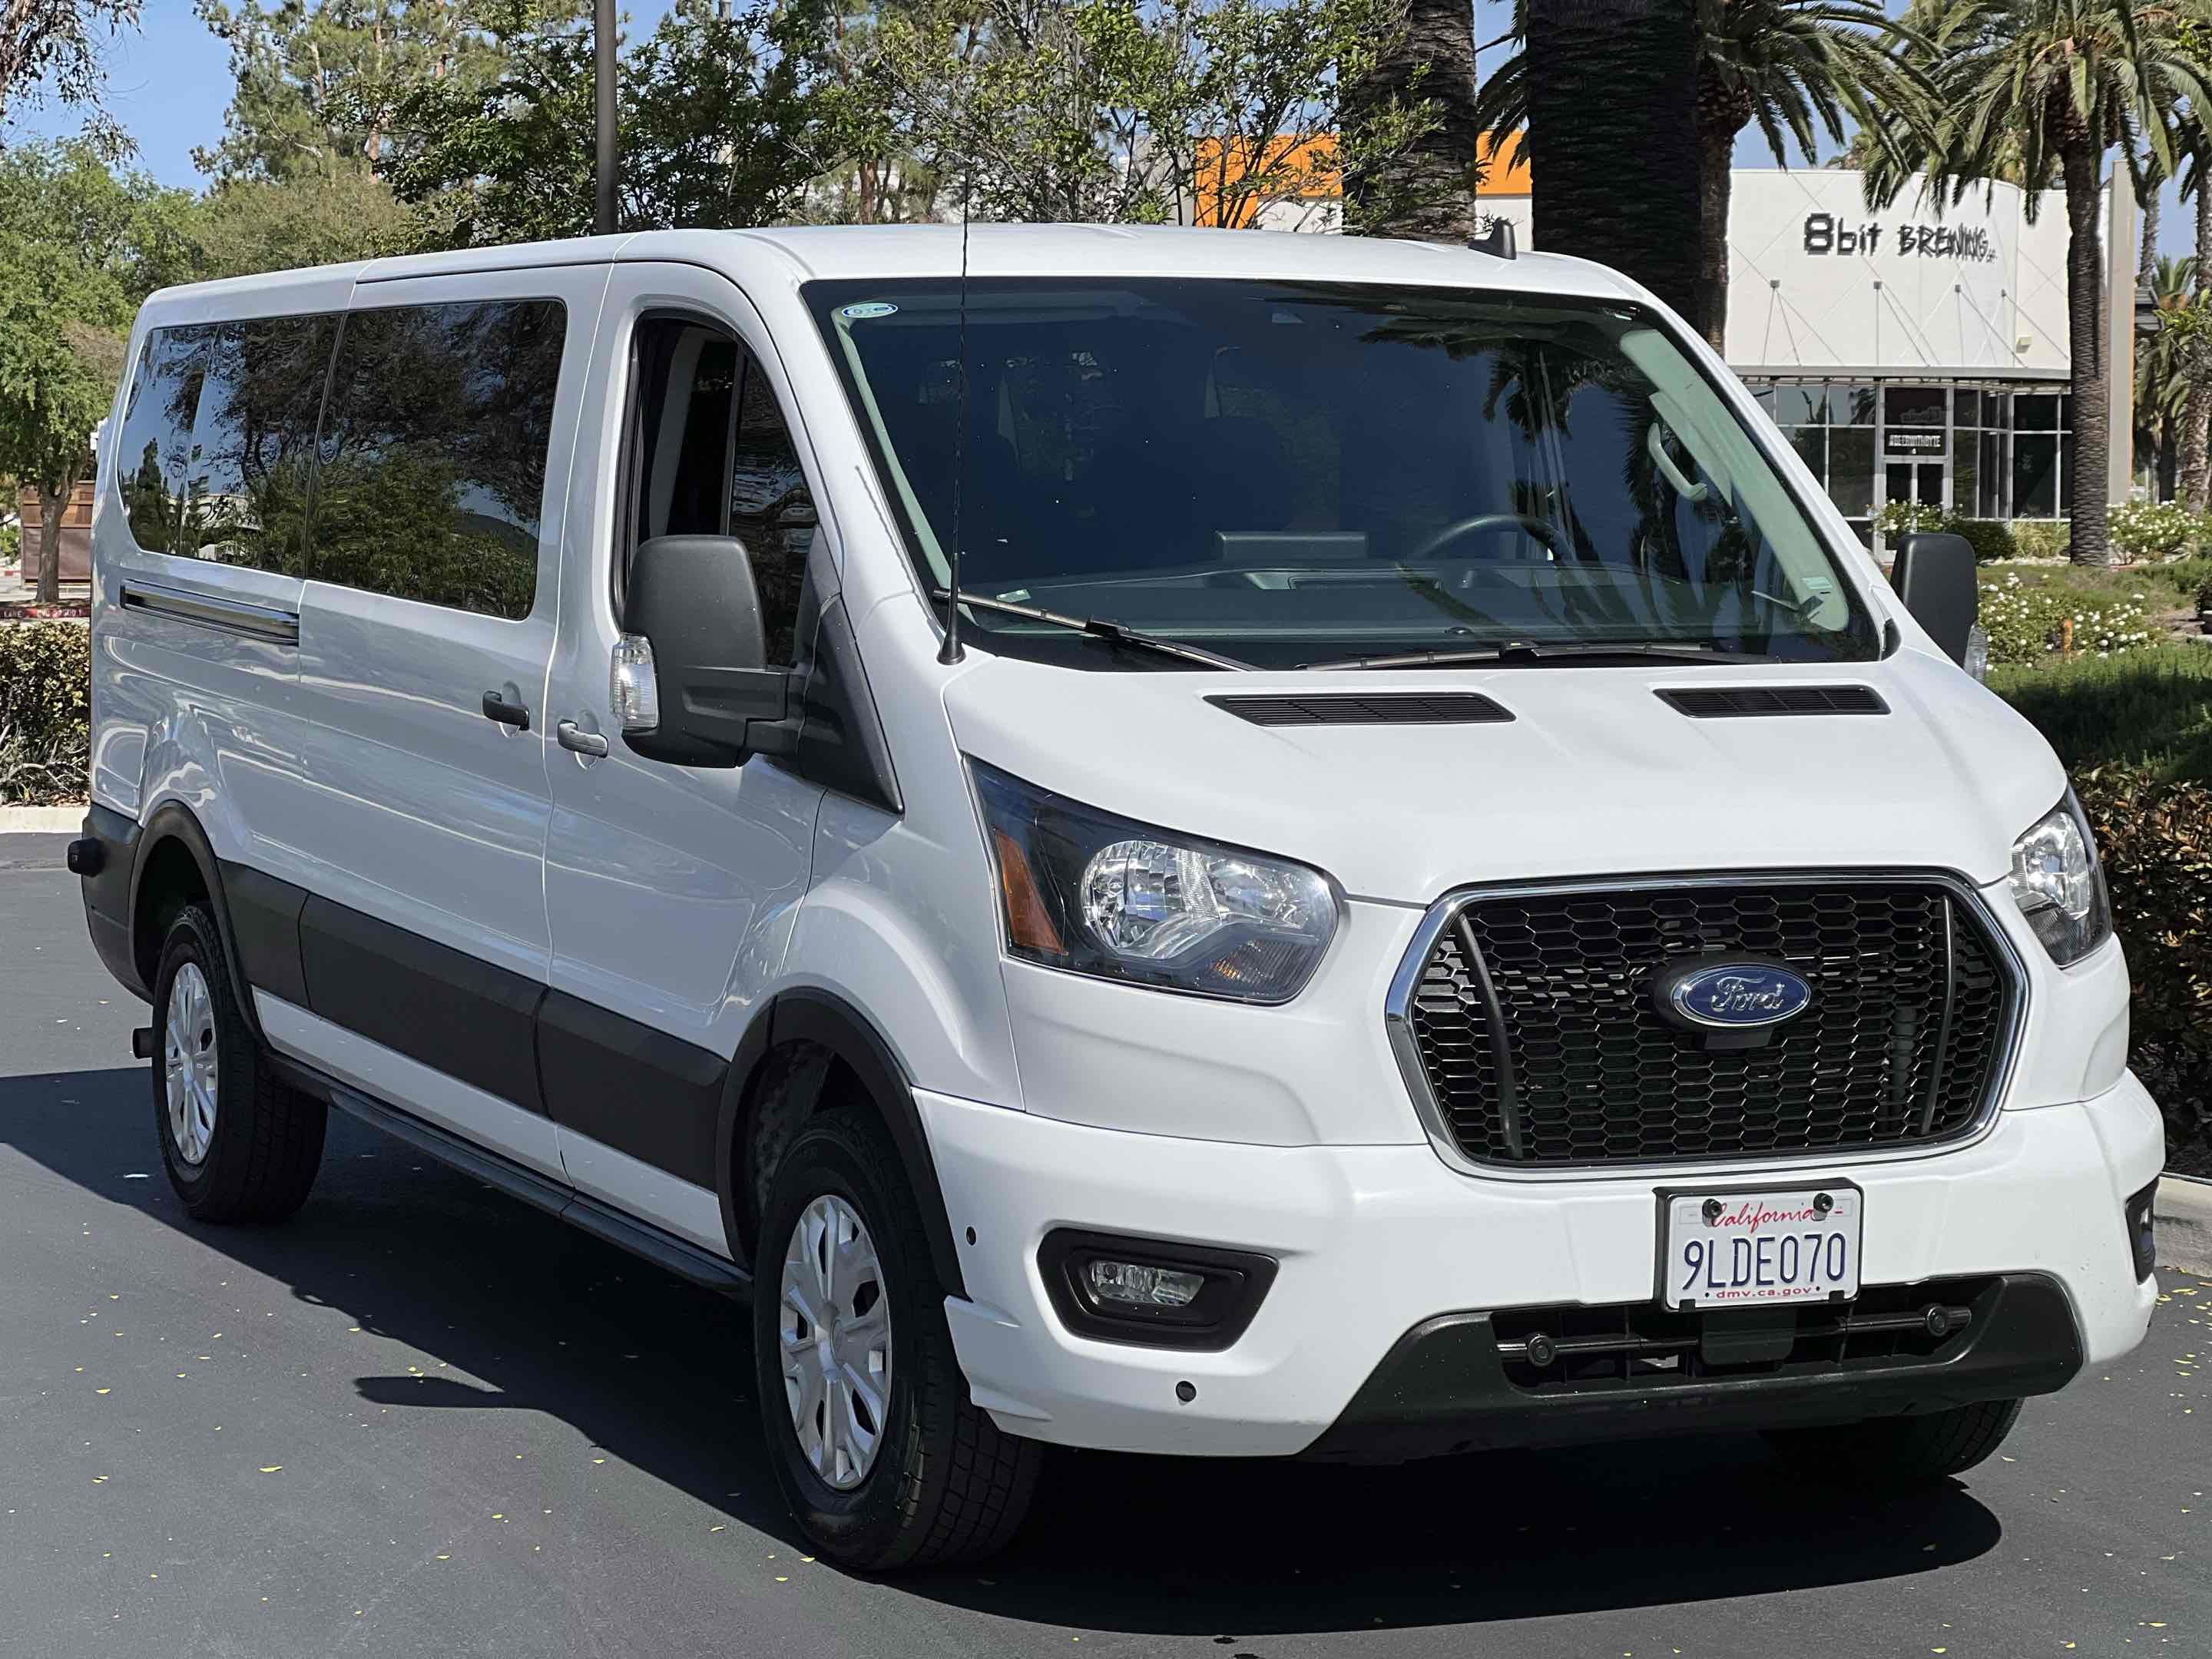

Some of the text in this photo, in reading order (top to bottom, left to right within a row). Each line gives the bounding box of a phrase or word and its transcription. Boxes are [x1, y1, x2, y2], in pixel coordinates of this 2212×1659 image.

[1804, 213, 1883, 256] 8bit
[1897, 223, 1989, 262] BREWING
[1710, 976, 1785, 1012] Ford
[1710, 1200, 1819, 1234] California
[1682, 1232, 1846, 1291] 9LDE070
[1716, 1286, 1813, 1300] dmv.ca.gov
